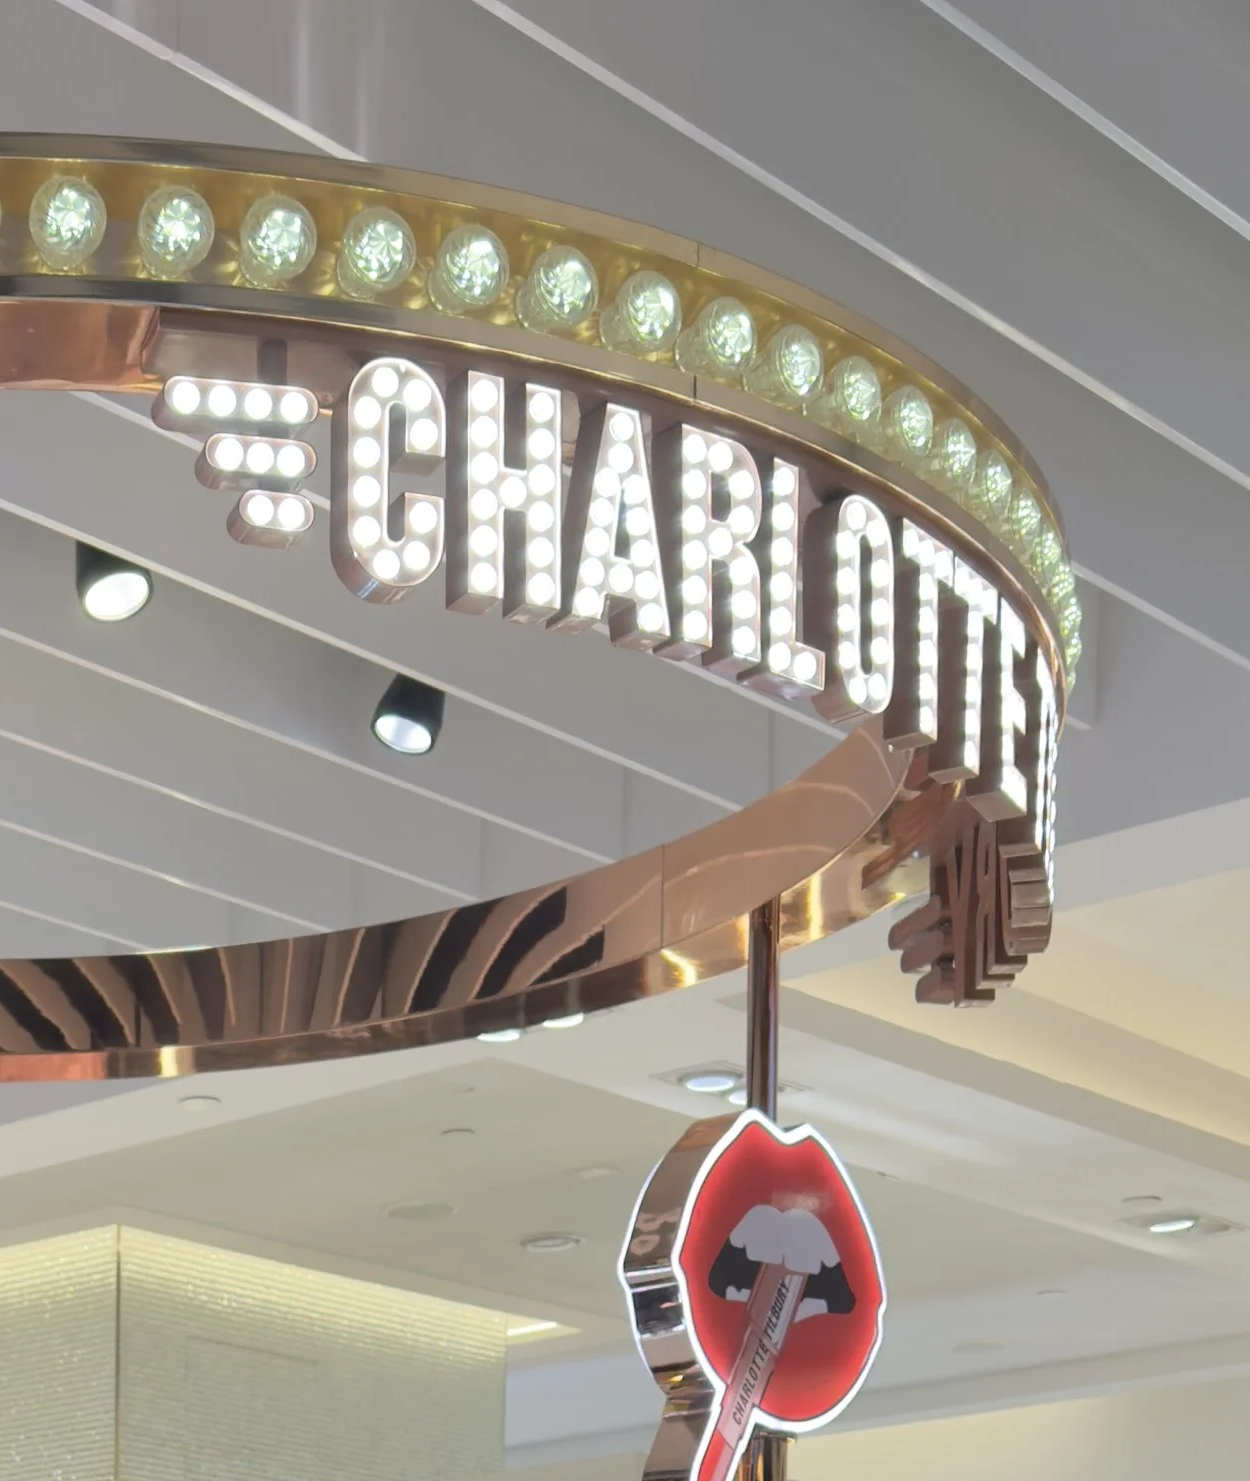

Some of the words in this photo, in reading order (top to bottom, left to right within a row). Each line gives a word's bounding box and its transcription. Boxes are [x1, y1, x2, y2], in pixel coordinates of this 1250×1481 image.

[338, 357, 1026, 817] CHARLOTTE
[733, 1339, 769, 1425] CHARLOTTE
[764, 1277, 791, 1342] TILBURY
